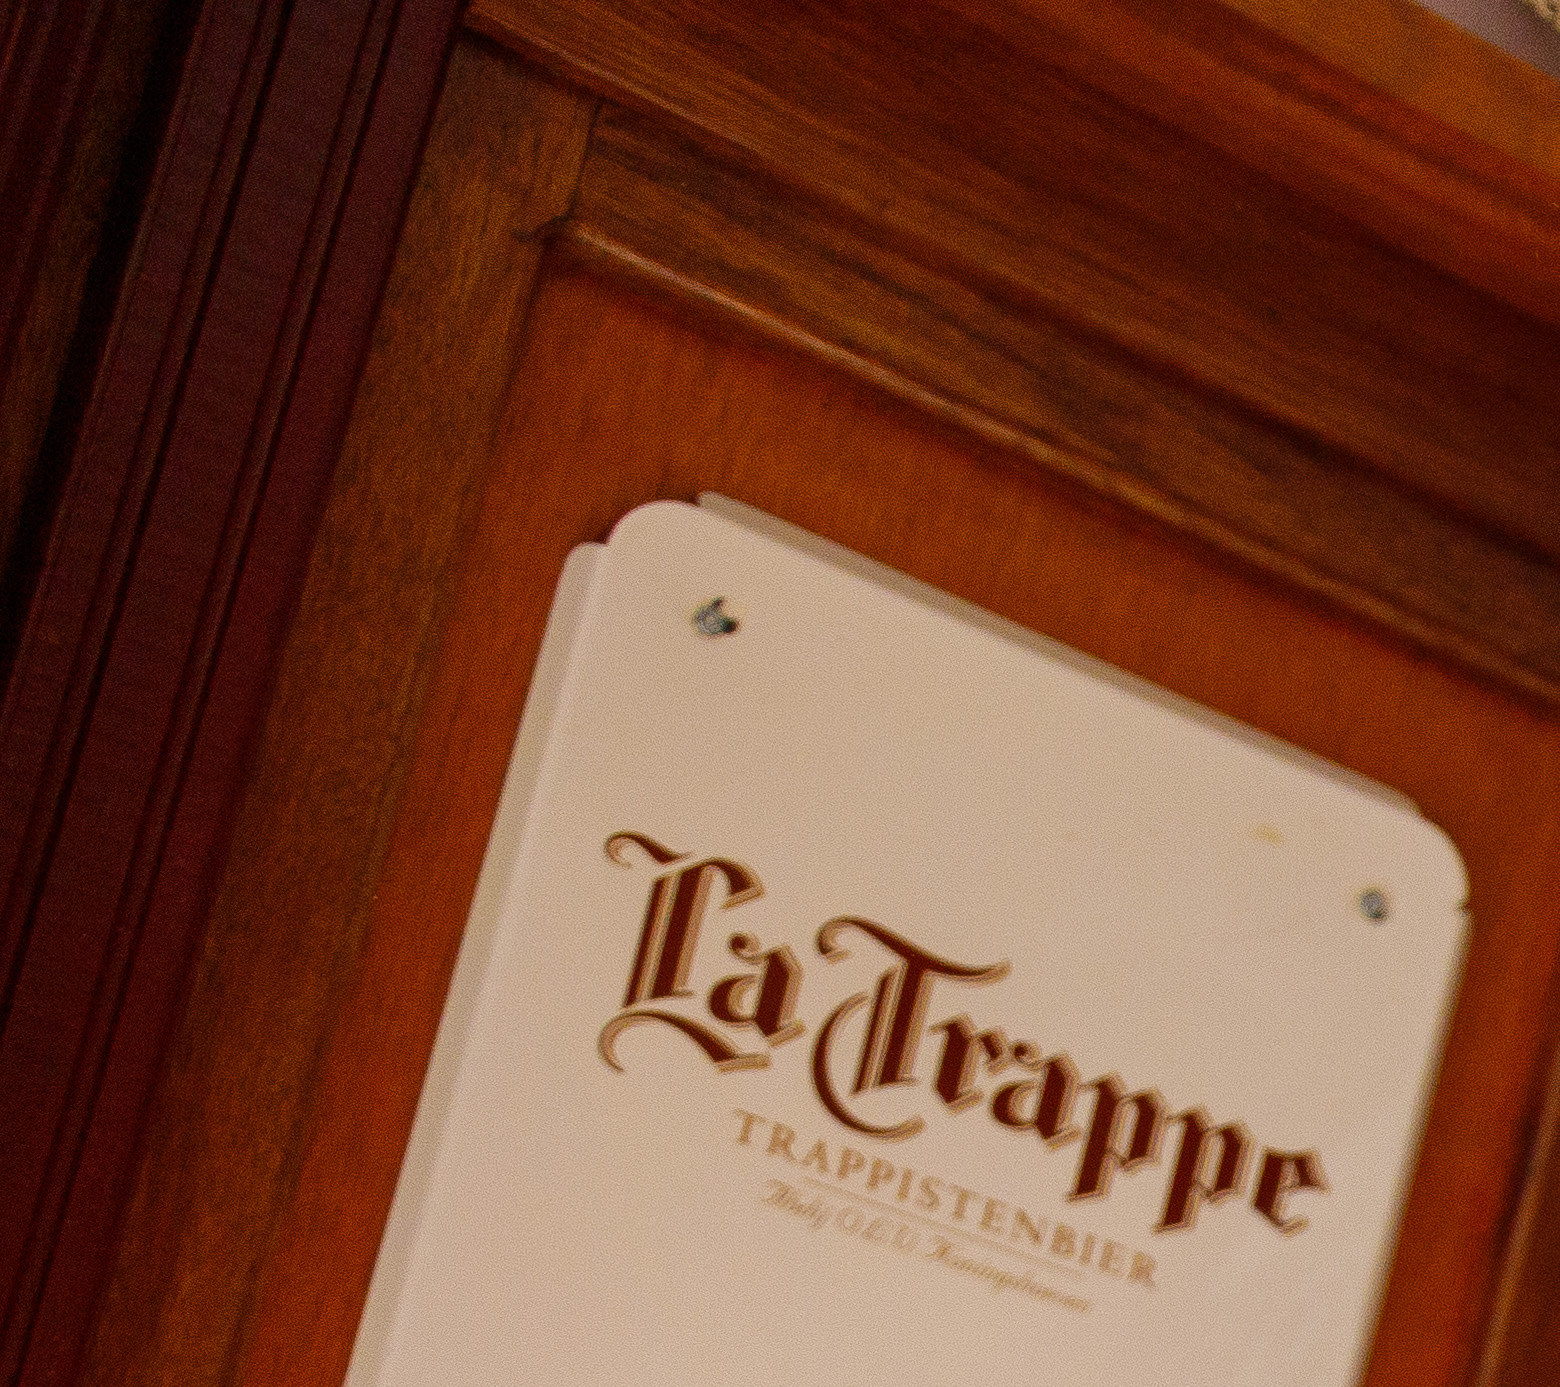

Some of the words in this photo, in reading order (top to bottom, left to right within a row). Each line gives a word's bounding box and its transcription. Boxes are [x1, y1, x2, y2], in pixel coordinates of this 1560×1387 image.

[598, 830, 806, 1074] La
[811, 914, 1328, 1237] Trappe
[734, 1107, 1158, 1289] TRAPPISTENBIER
